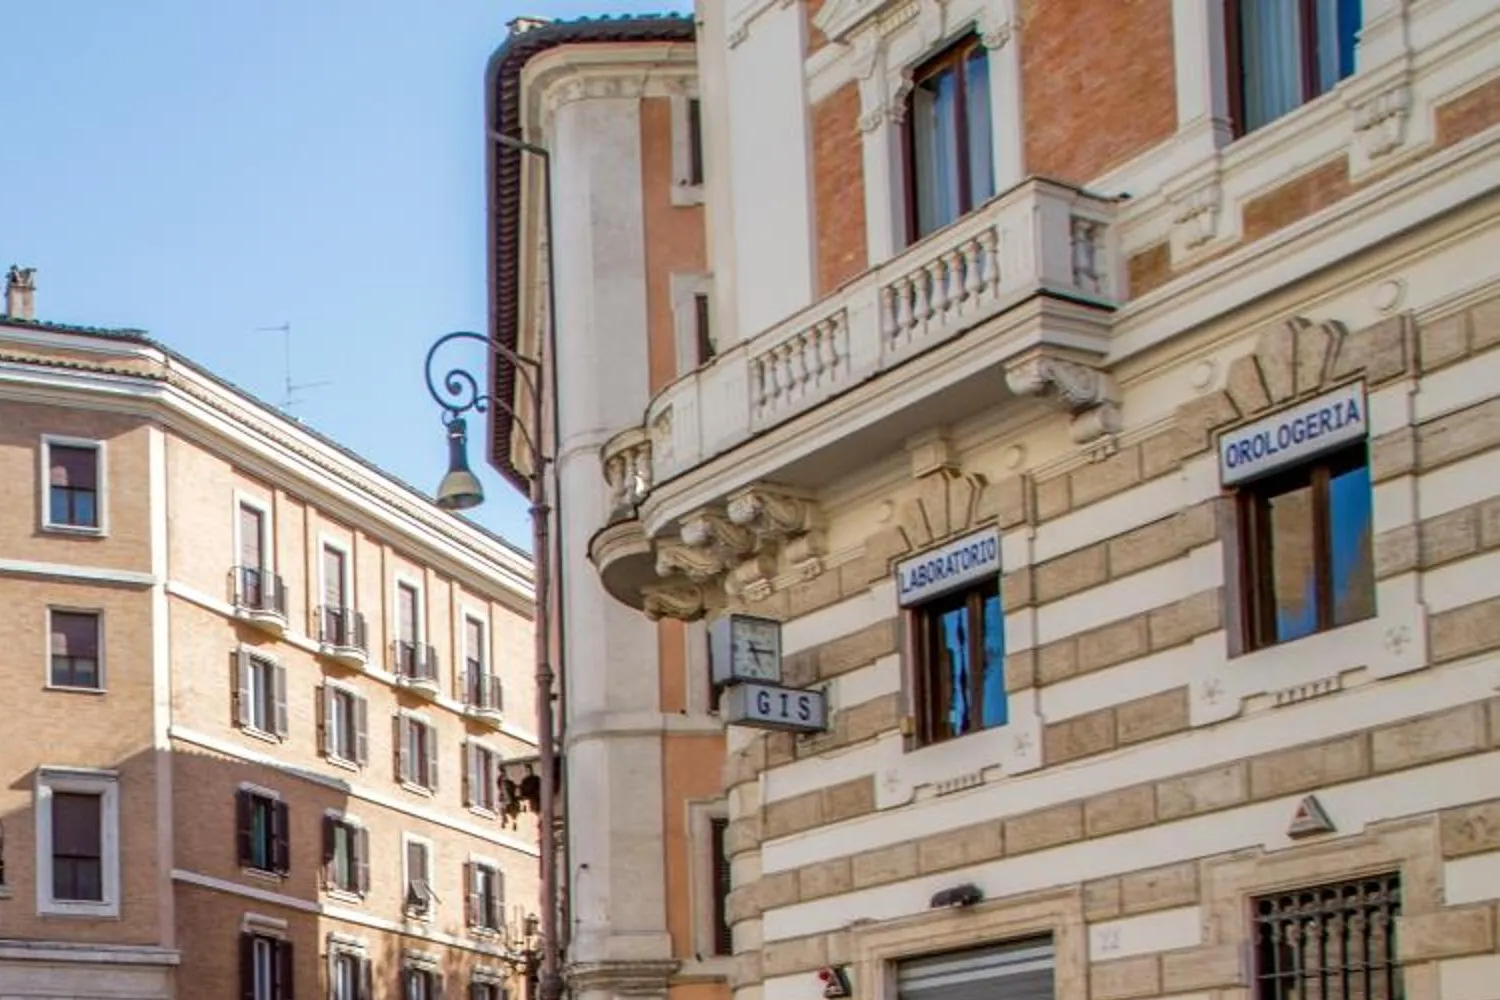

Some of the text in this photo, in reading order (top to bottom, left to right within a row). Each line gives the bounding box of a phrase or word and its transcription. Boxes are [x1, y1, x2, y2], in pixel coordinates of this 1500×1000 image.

[1225, 398, 1360, 468] OROLOGERIA
[900, 537, 995, 593] LABORATORIO
[757, 690, 810, 721] GIS
